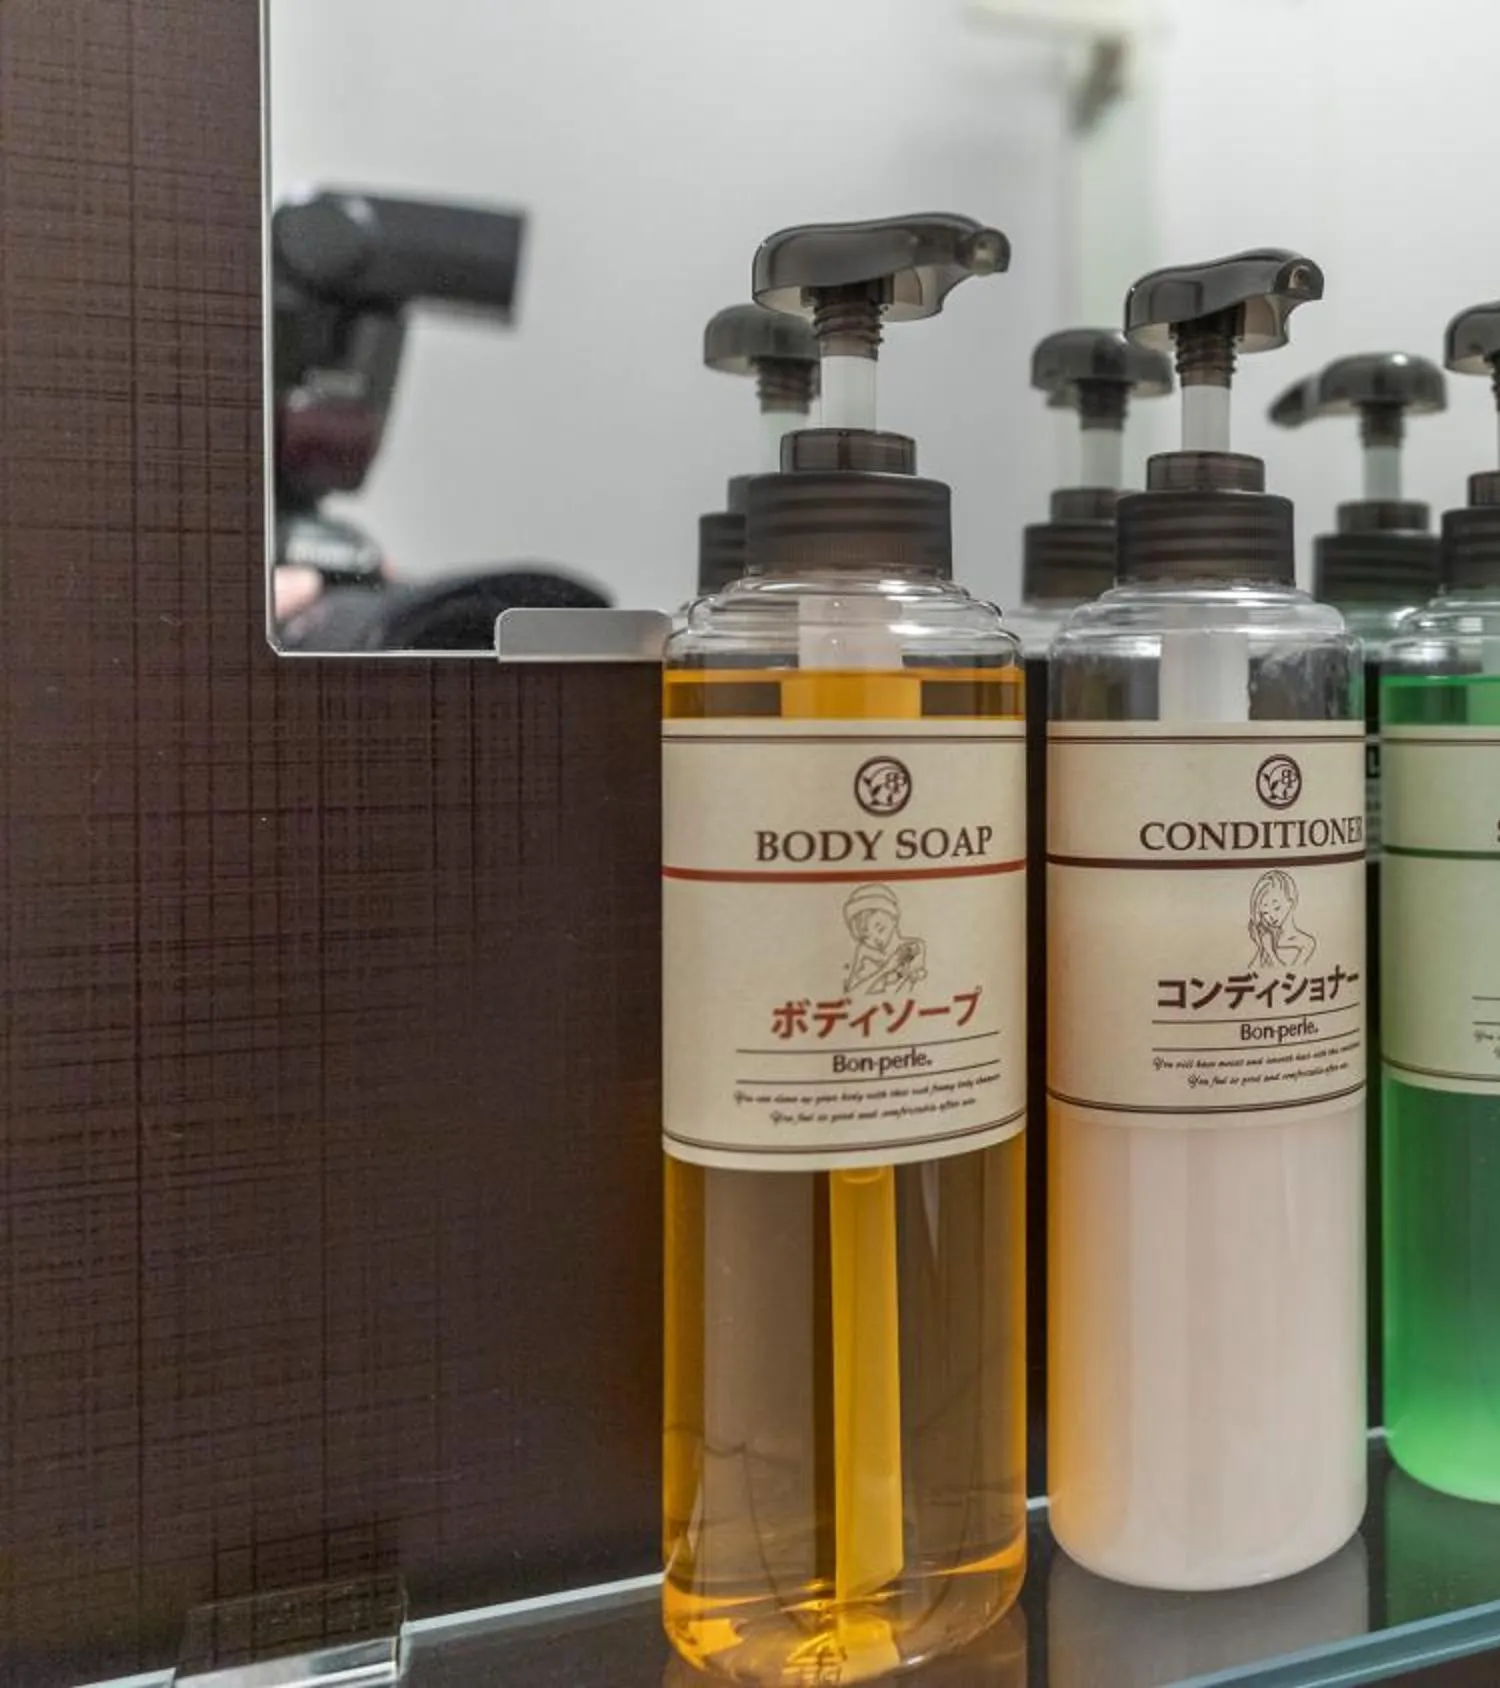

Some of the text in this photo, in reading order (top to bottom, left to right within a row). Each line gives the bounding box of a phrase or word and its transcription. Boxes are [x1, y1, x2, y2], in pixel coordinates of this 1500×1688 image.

[754, 825, 993, 863] BODY SOAP
[1157, 964, 1360, 1011] コンディショナー
[771, 985, 983, 1039] ボディソープ
